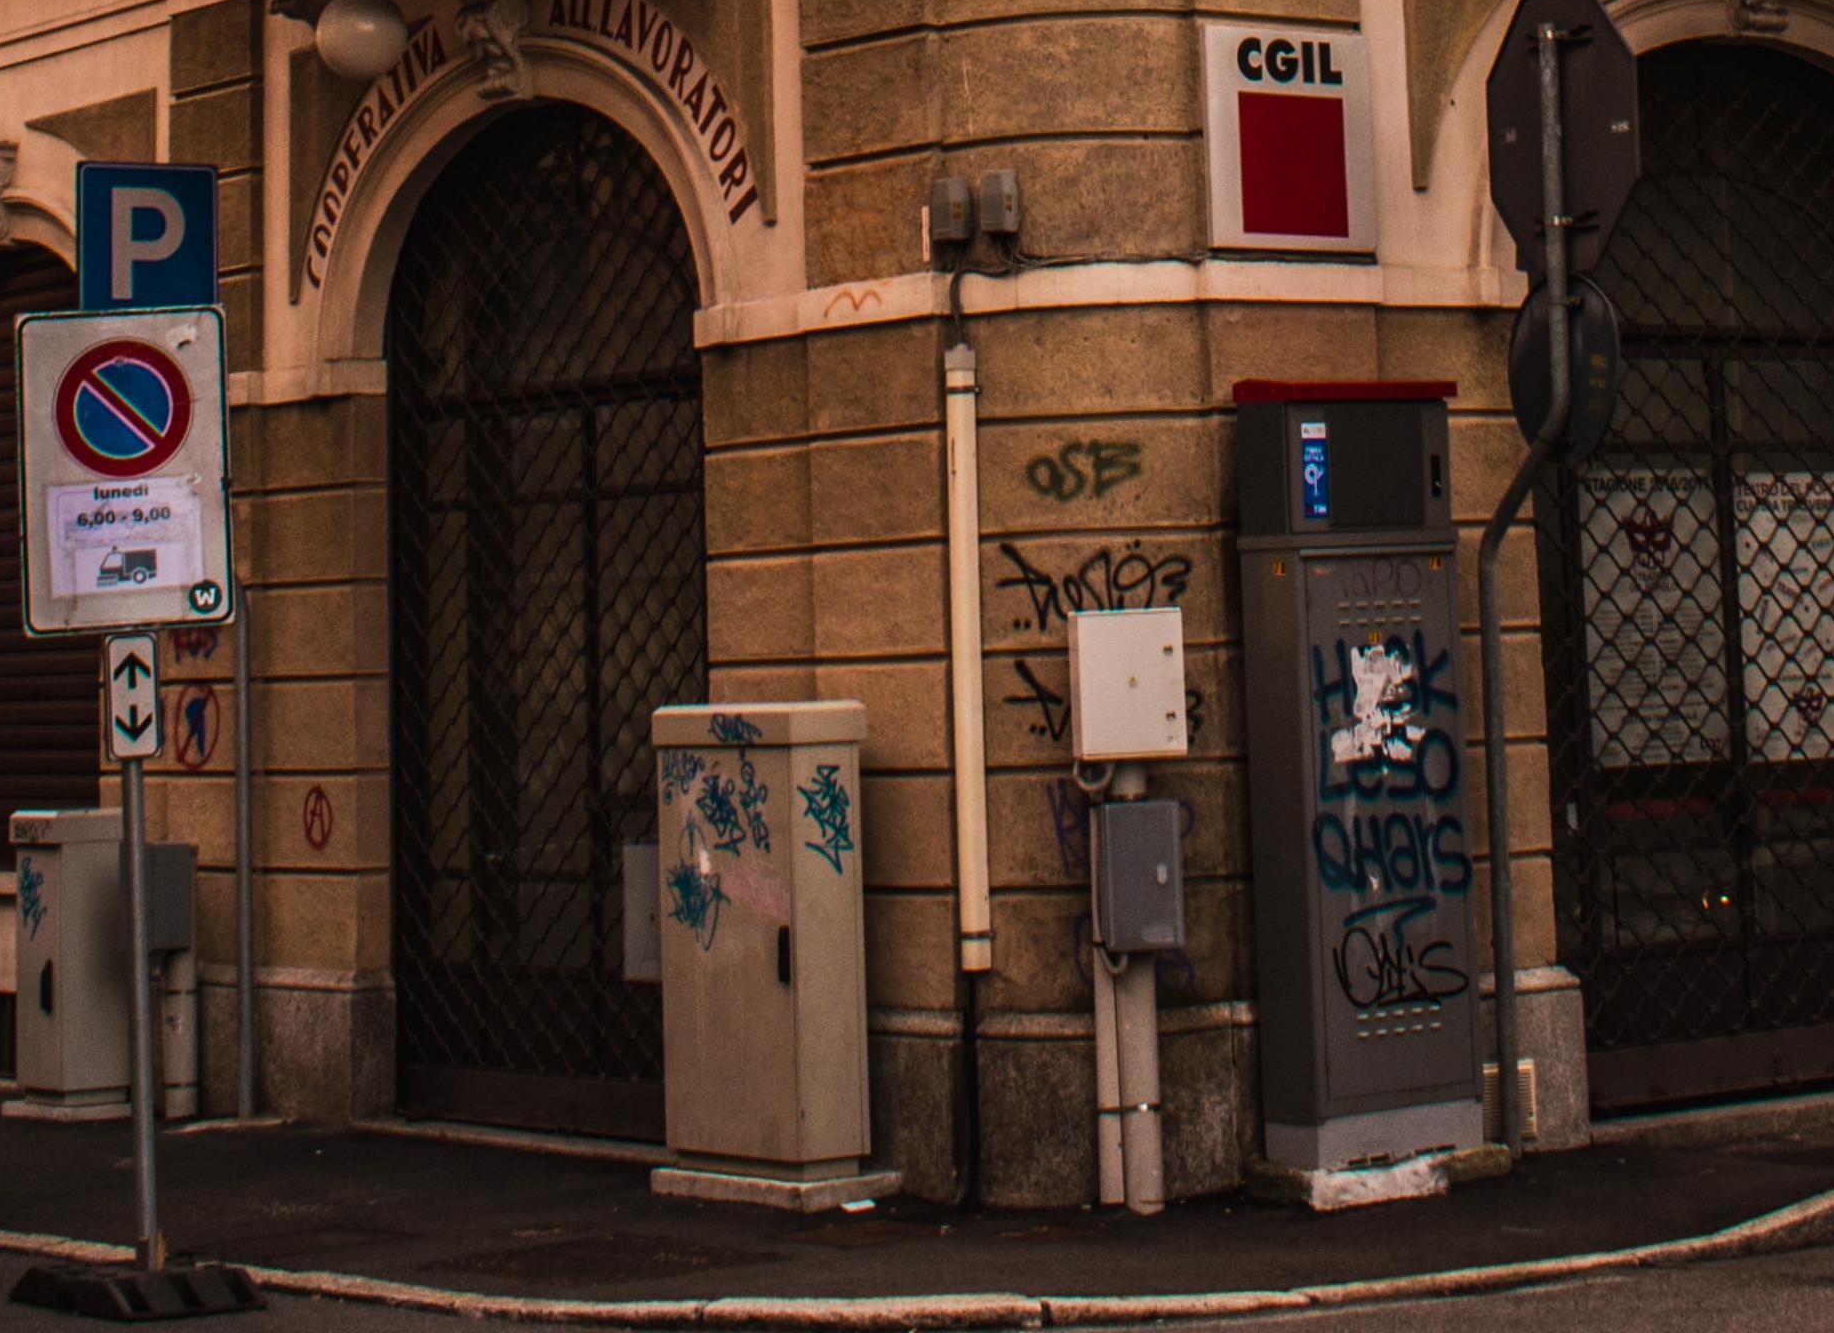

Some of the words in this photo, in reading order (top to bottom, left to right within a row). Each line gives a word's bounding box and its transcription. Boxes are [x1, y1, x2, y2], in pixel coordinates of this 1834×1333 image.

[1236, 35, 1344, 86] CGIL
[110, 186, 186, 301] P
[76, 510, 117, 529] 6,00
[132, 506, 172, 525] 9,00
